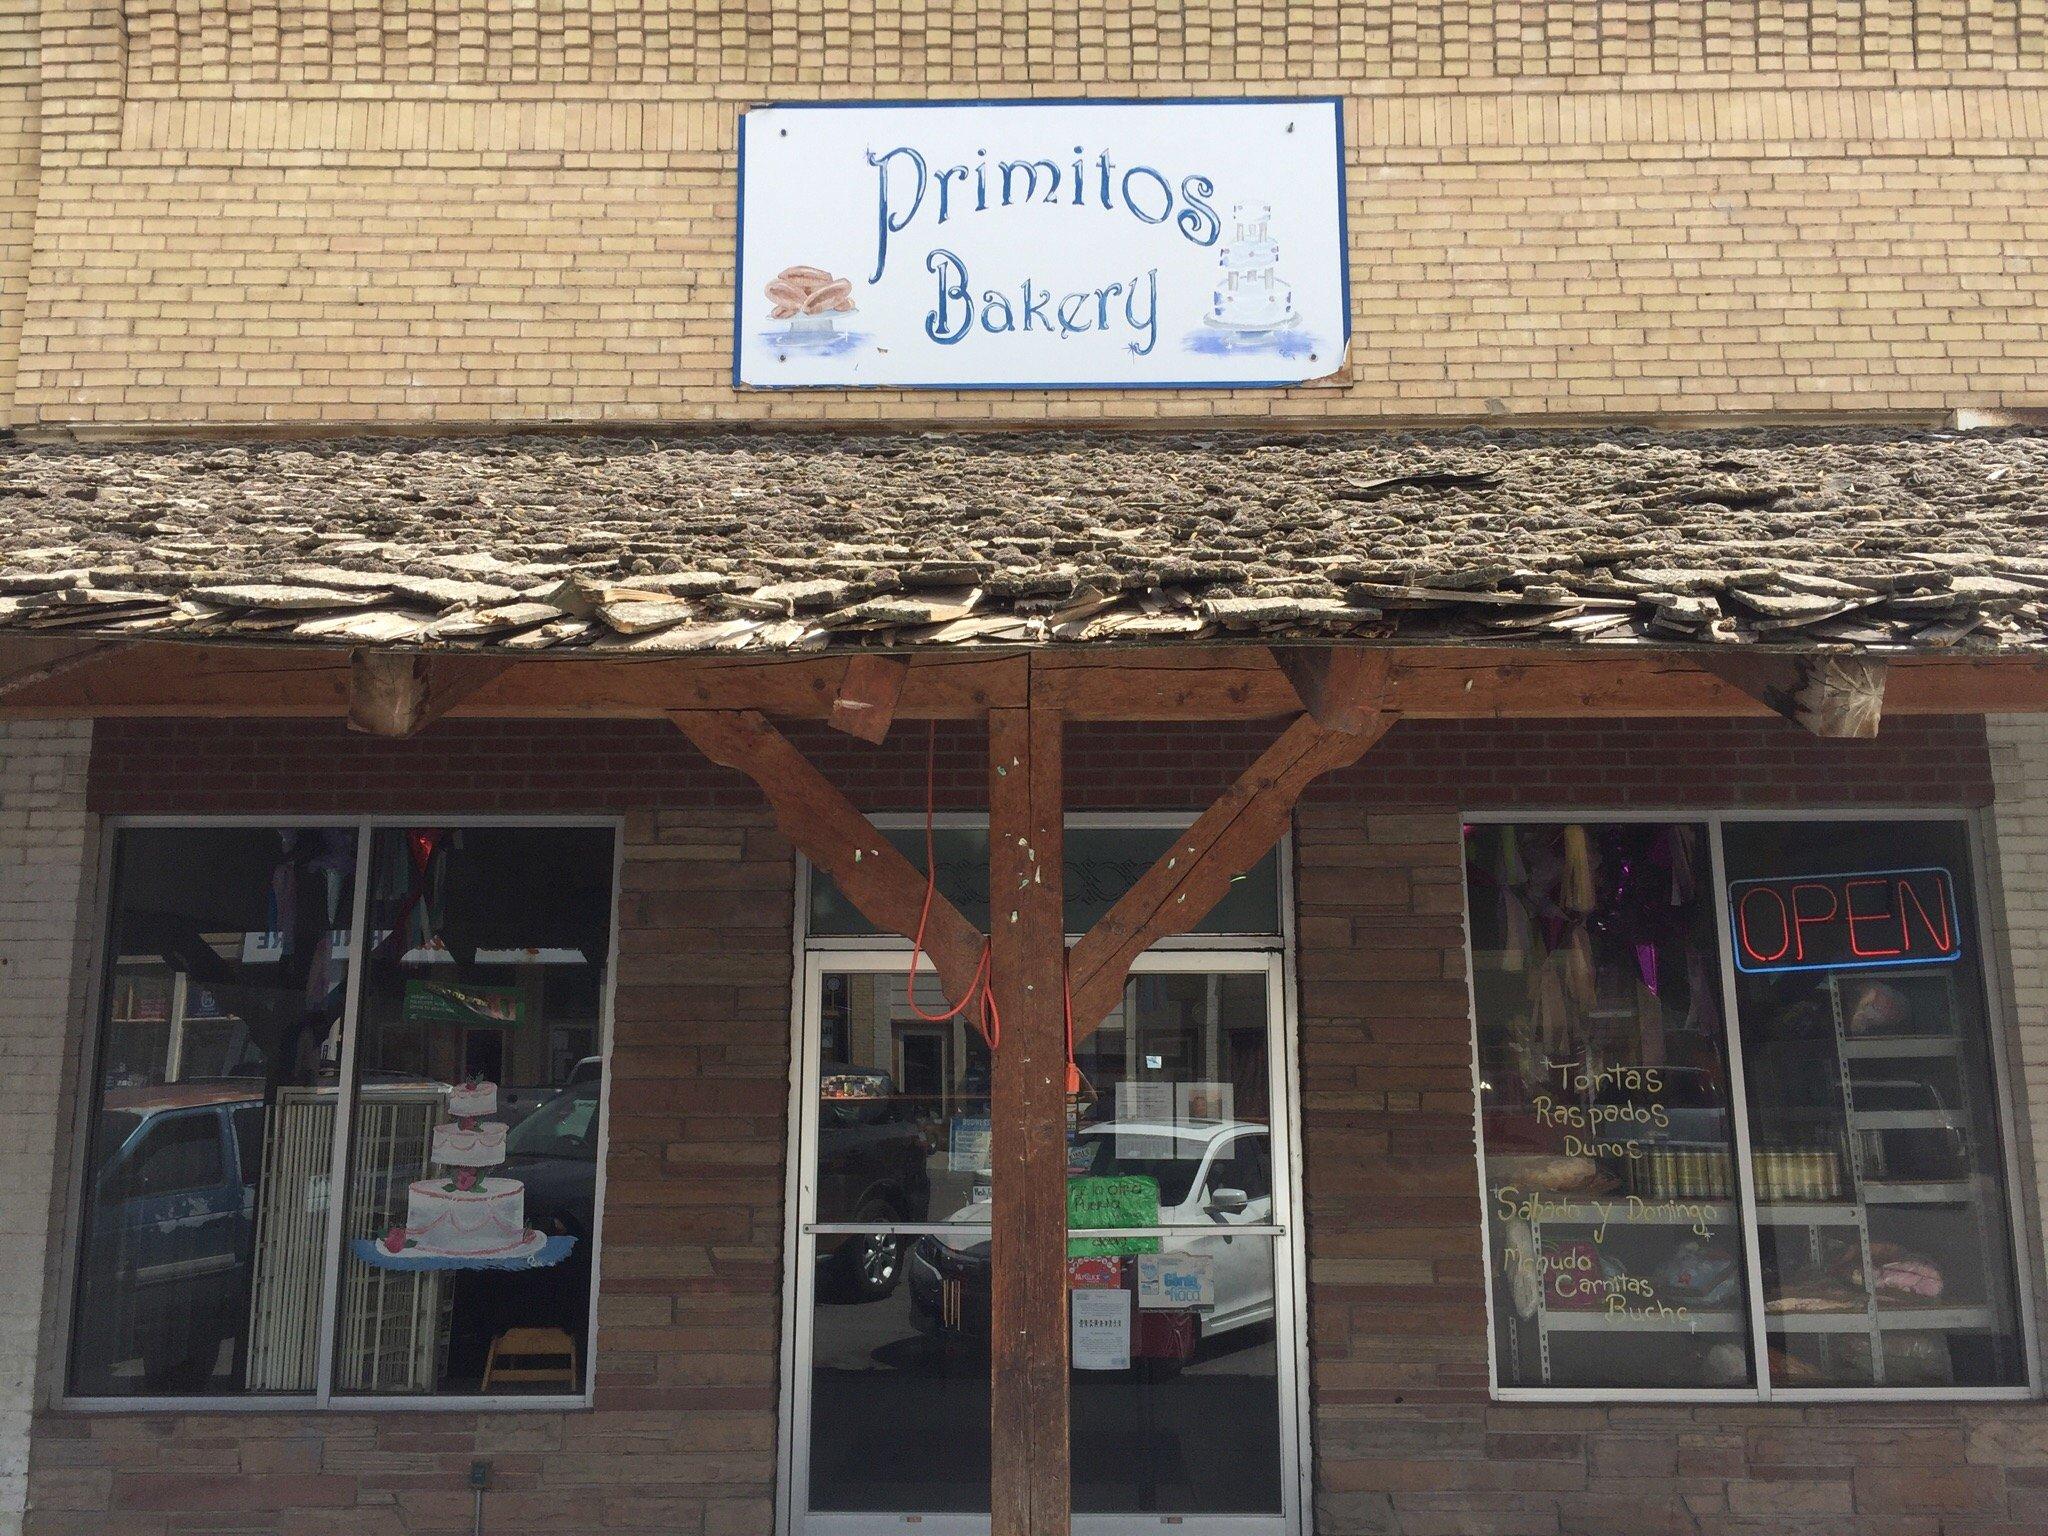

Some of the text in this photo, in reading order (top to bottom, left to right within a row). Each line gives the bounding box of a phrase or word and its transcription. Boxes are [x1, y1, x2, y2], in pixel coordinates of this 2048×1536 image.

[925, 248, 1157, 355] Bakery
[1740, 877, 1951, 961] OPEN
[1549, 1062, 1663, 1093] Tortas
[1532, 1095, 1670, 1136] Raspados
[1563, 1134, 1644, 1159] Duros
[1497, 1186, 1718, 1244] Sabado y Domingo
[1503, 1247, 1593, 1275] Menudo
[1554, 1272, 1655, 1298] Carnitas
[1603, 1293, 1693, 1325] Buche
